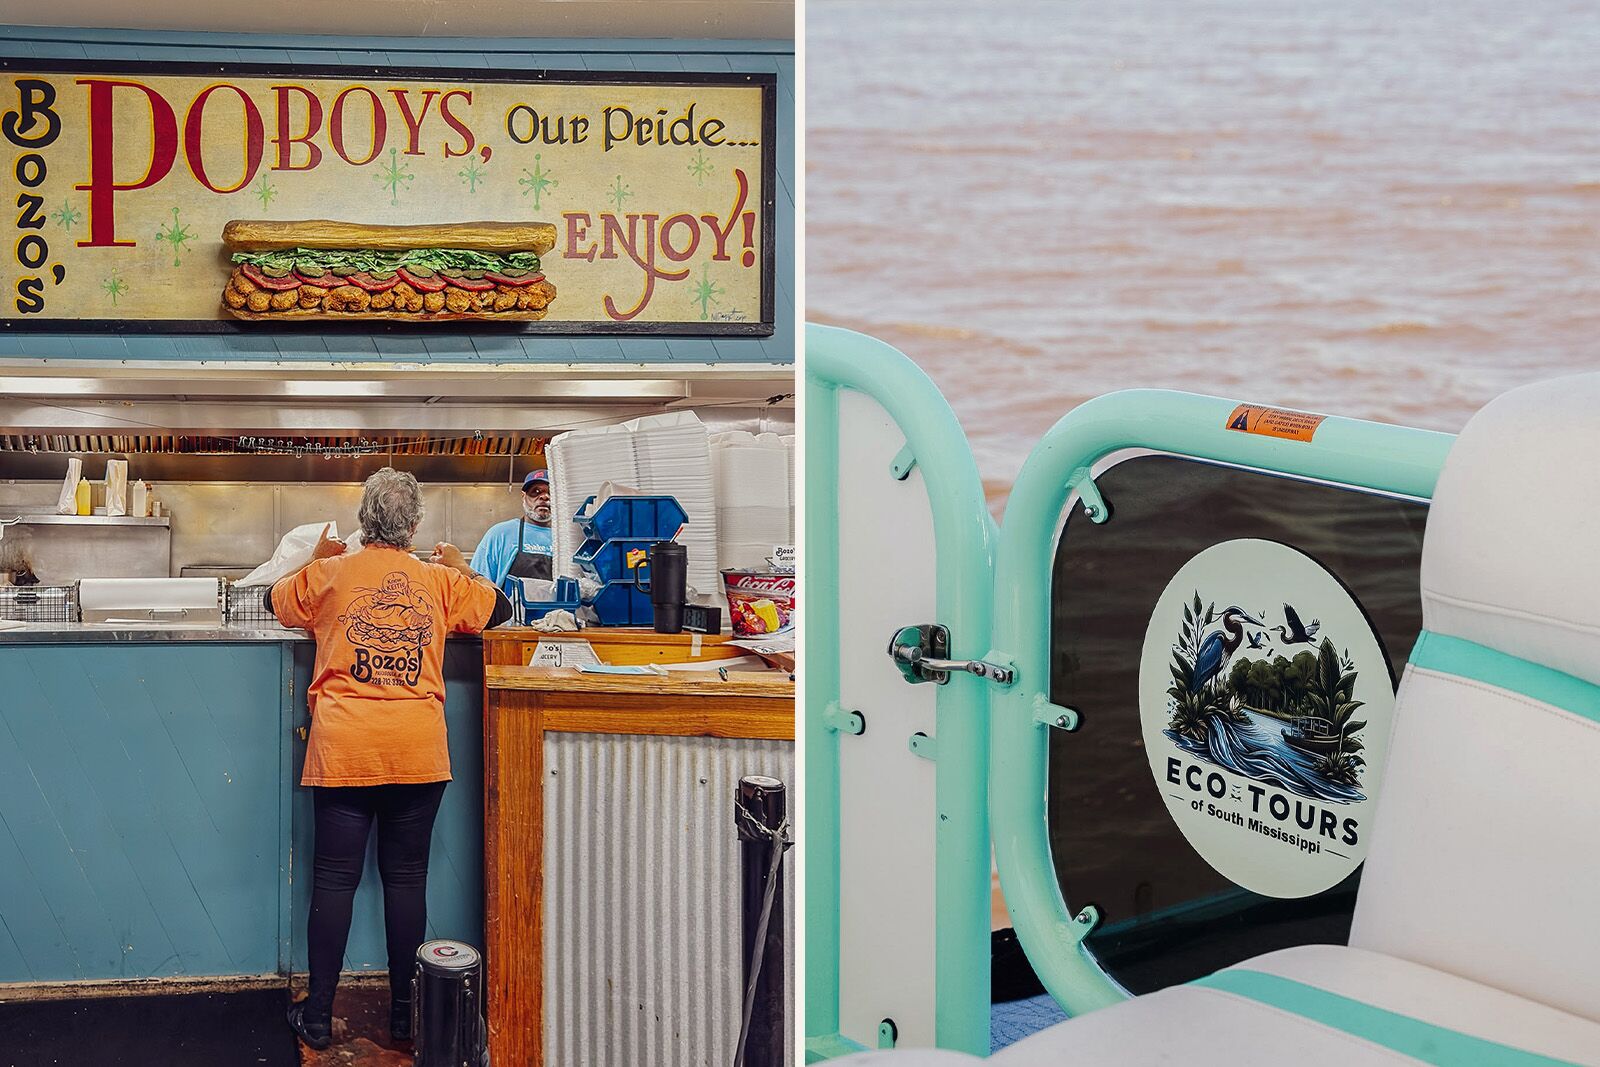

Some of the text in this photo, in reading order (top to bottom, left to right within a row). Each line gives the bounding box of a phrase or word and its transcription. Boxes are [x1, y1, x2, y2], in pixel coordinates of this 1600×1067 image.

[75, 80, 759, 248] POBOYS, Our Pride...
[563, 168, 757, 321] ENJOY!
[1166, 756, 1359, 846] ECO TOURS
[1191, 800, 1321, 854] of South Mississippi
